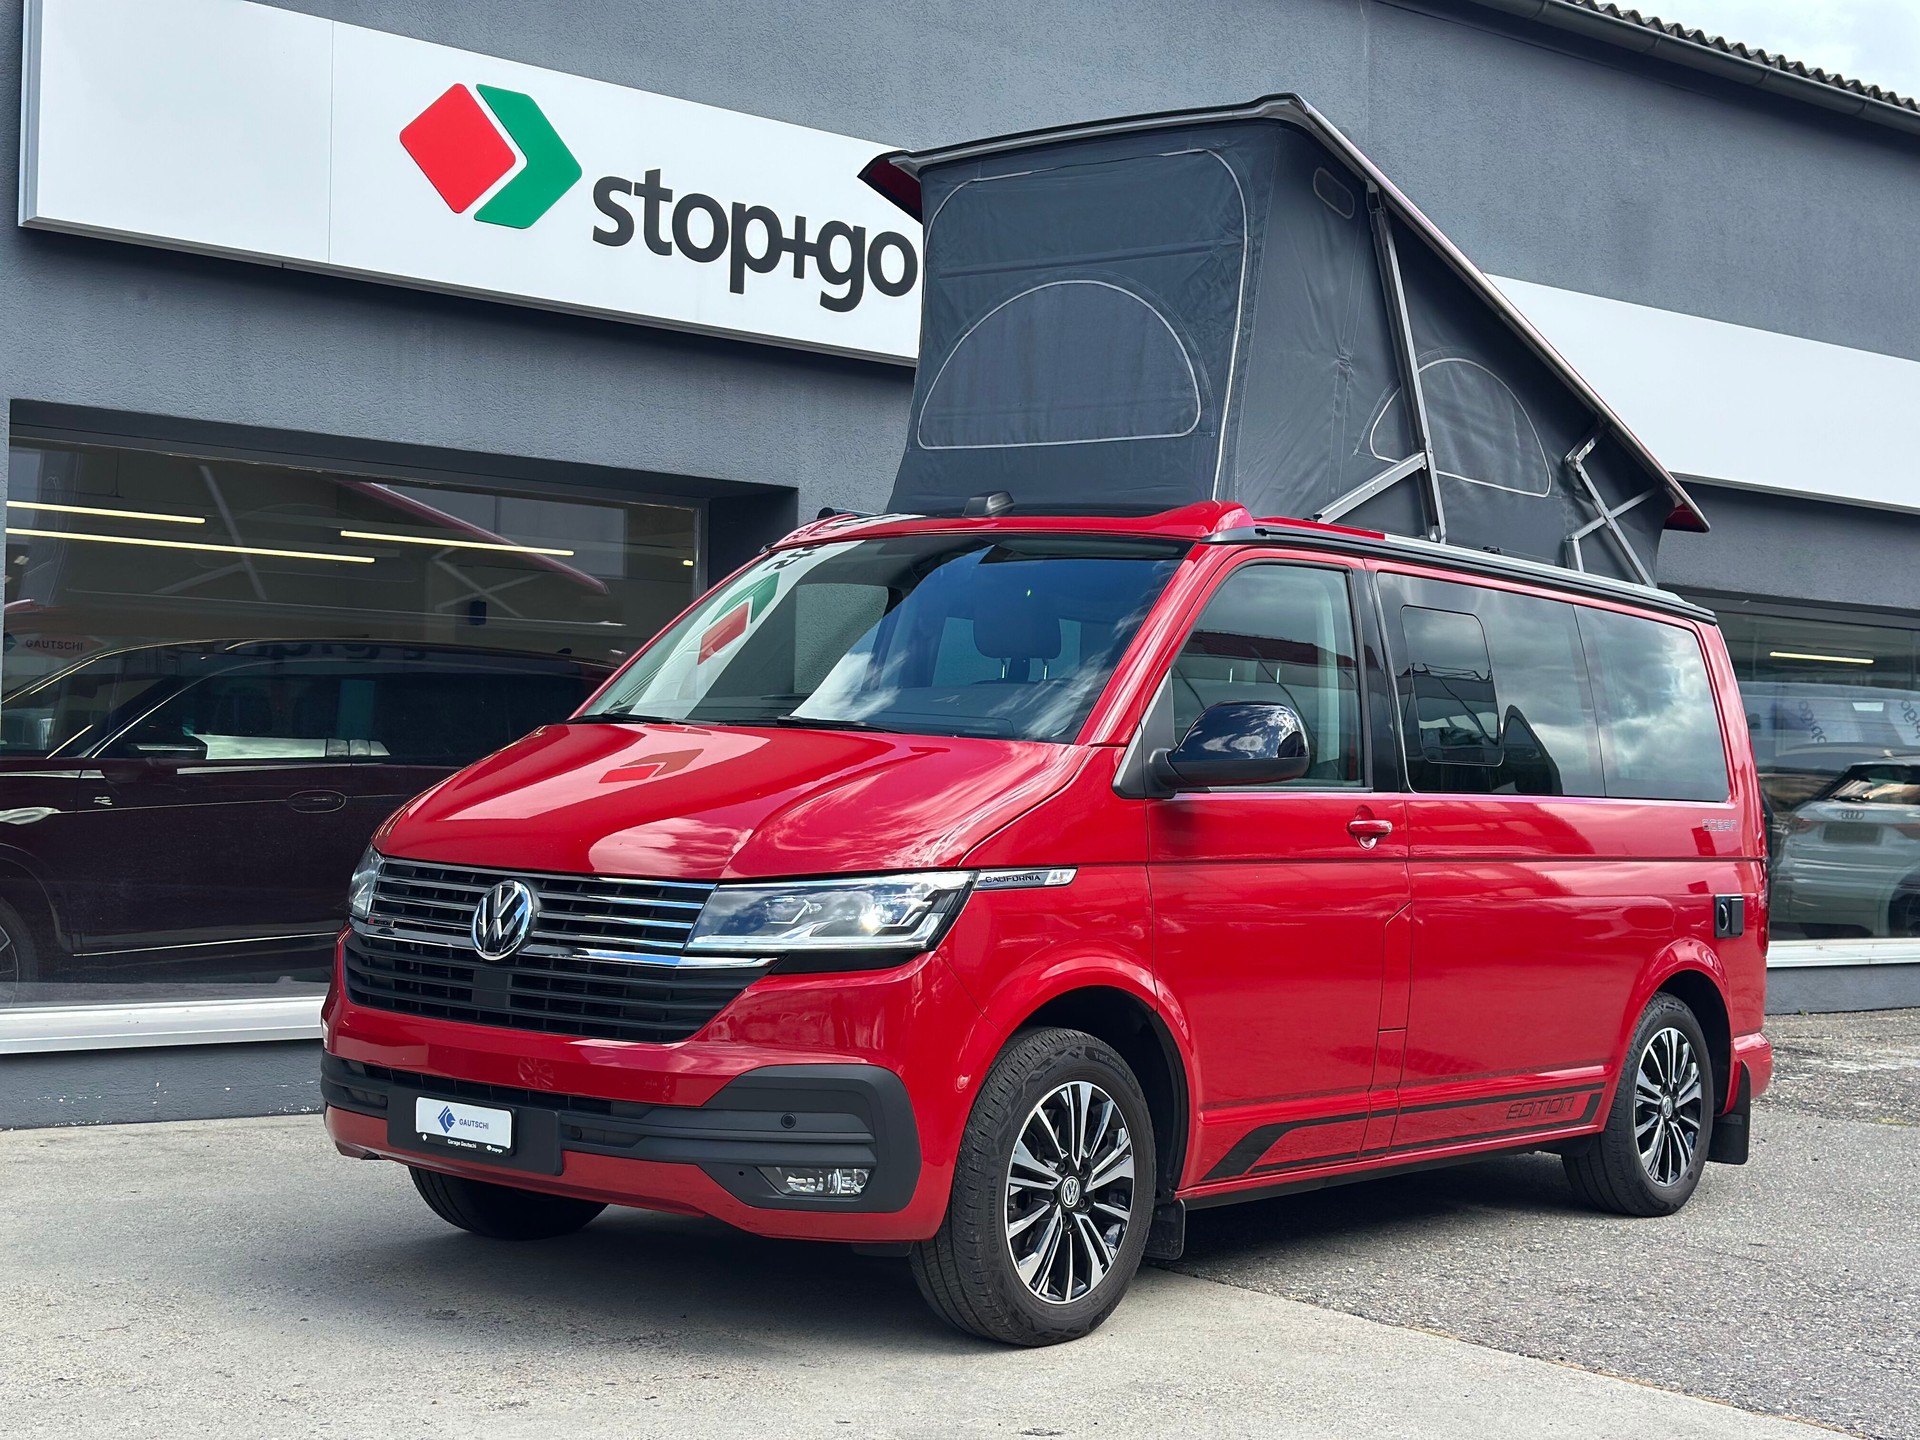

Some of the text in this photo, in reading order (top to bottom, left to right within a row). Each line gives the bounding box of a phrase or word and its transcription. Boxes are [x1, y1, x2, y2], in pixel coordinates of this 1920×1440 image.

[593, 169, 918, 312] stop+go
[985, 874, 1041, 883] CALIFORNIA
[1506, 1096, 1575, 1119] EDITION
[459, 1118, 489, 1130] GAUTSCHI
